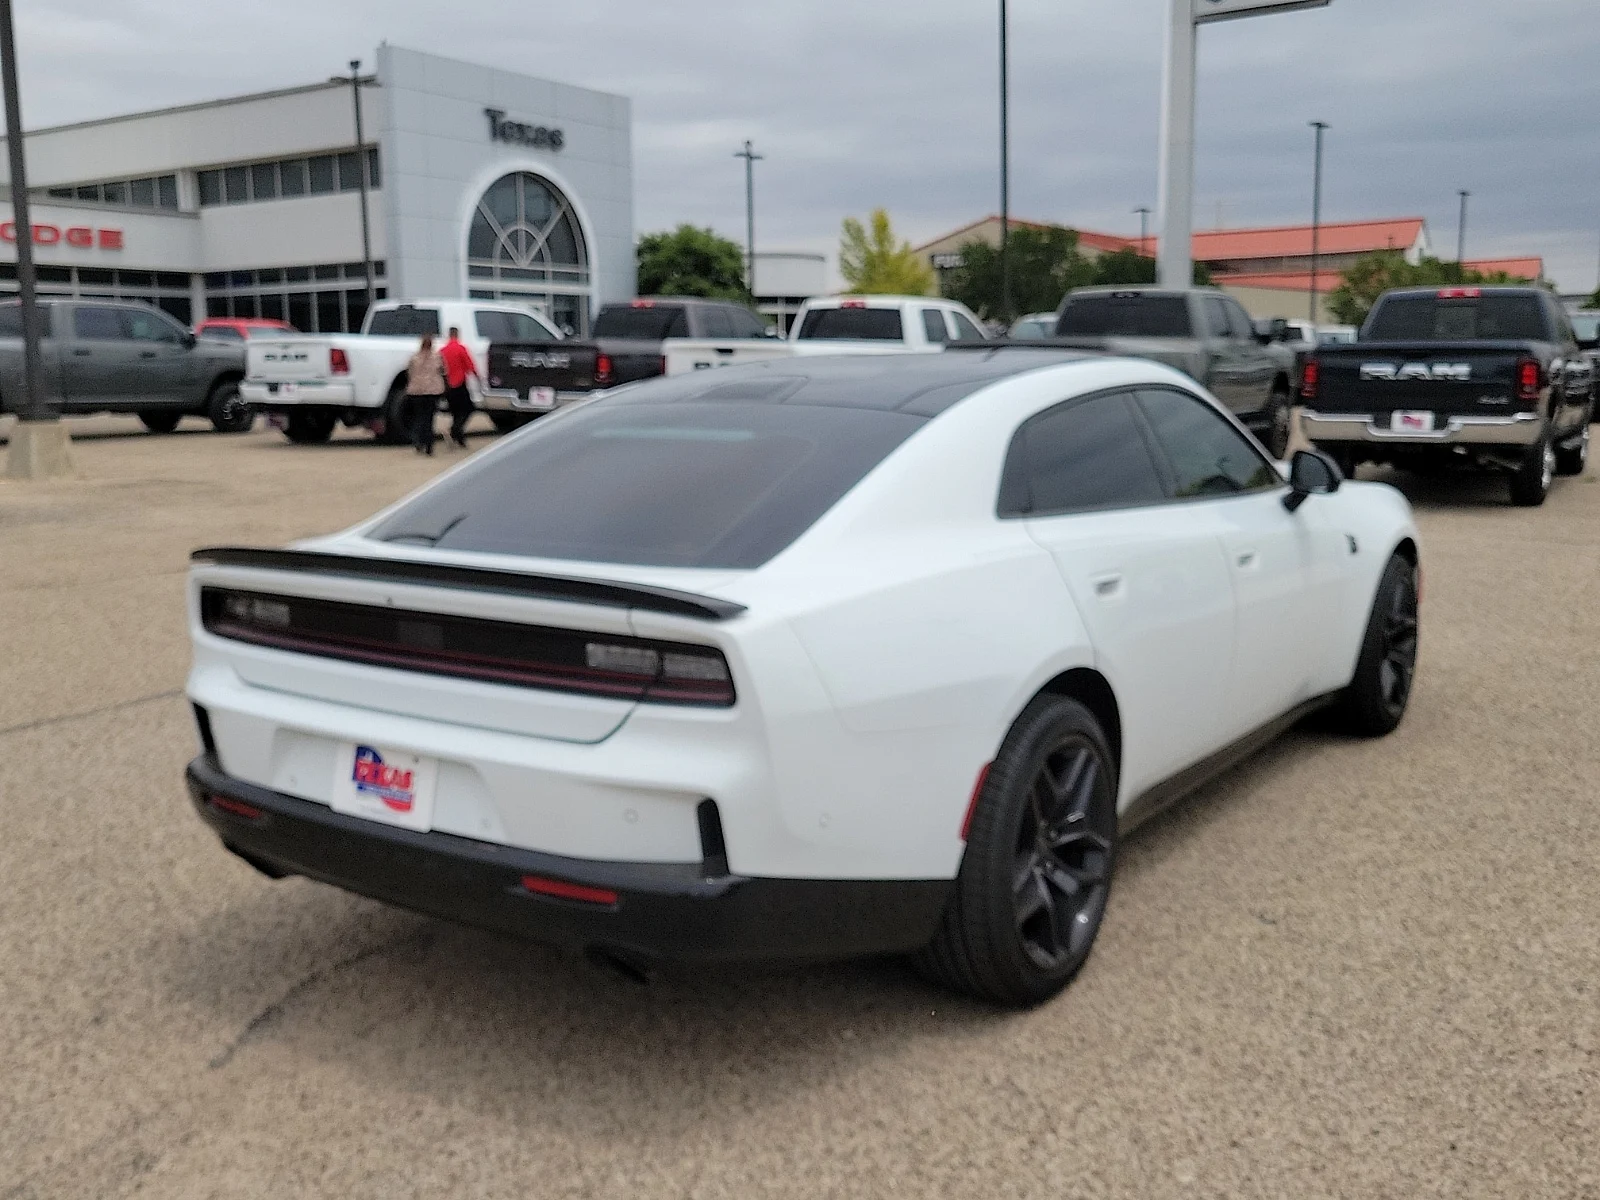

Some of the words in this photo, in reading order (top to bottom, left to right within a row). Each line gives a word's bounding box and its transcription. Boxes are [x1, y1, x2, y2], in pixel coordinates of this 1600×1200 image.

[483, 107, 565, 152] Texas
[510, 351, 571, 369] RAM
[1359, 363, 1472, 381] RAM
